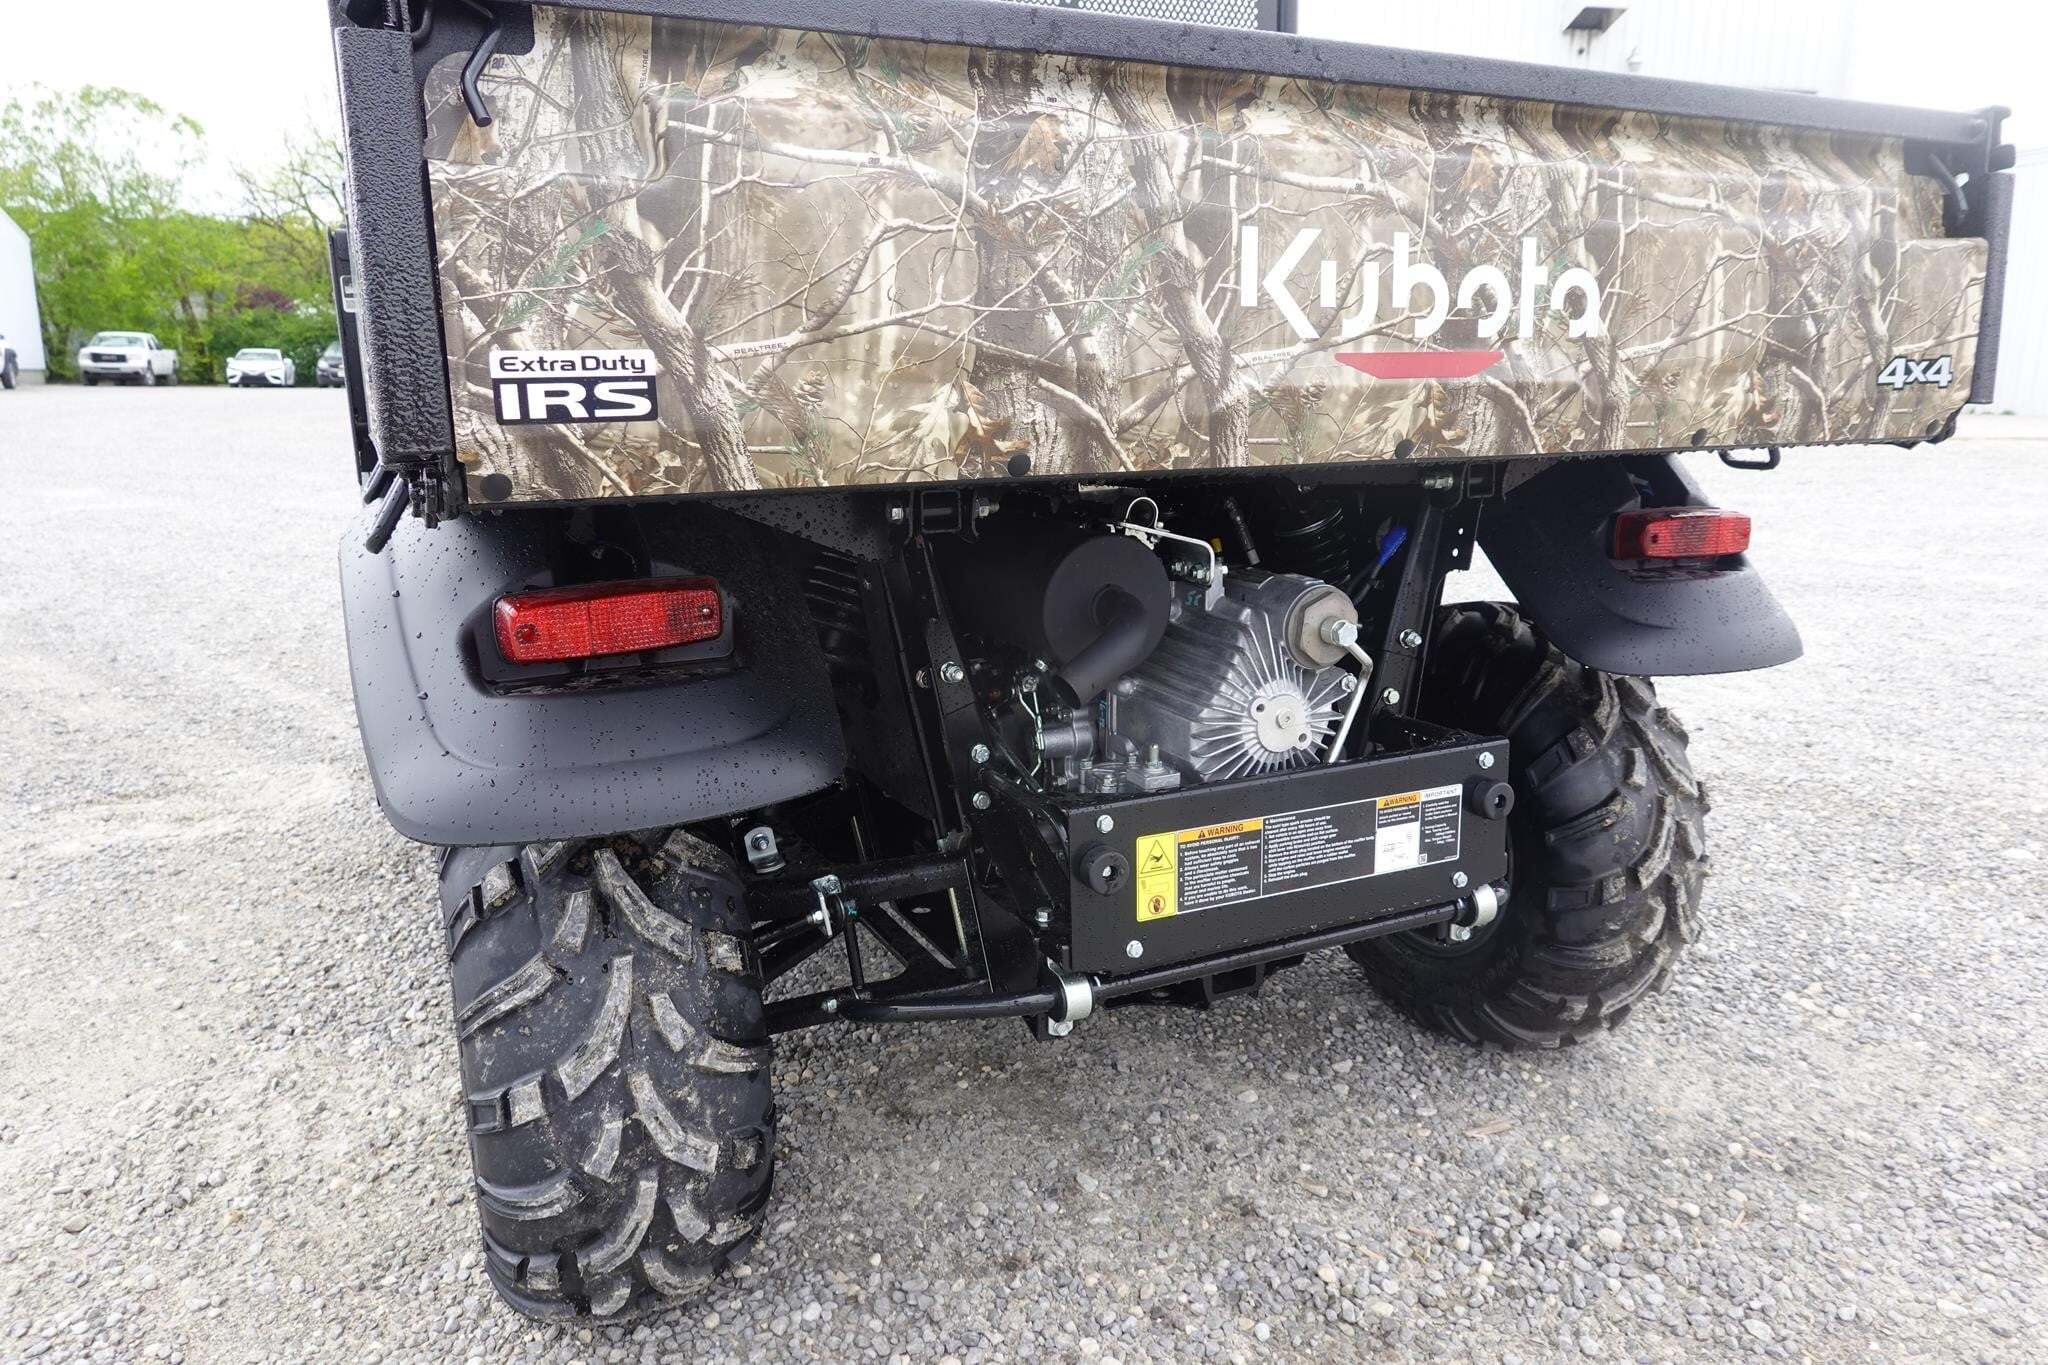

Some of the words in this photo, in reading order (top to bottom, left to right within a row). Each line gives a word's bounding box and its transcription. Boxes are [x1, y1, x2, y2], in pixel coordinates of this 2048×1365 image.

[1240, 225, 1600, 340] Kubota
[734, 342, 785, 354] REALTREE
[499, 356, 576, 372] Extra
[581, 355, 646, 374] Duty
[1877, 356, 1953, 389] 4x4
[499, 381, 651, 420] IRS
[1390, 795, 1417, 805] WARNING
[1207, 824, 1244, 836] WARNING
